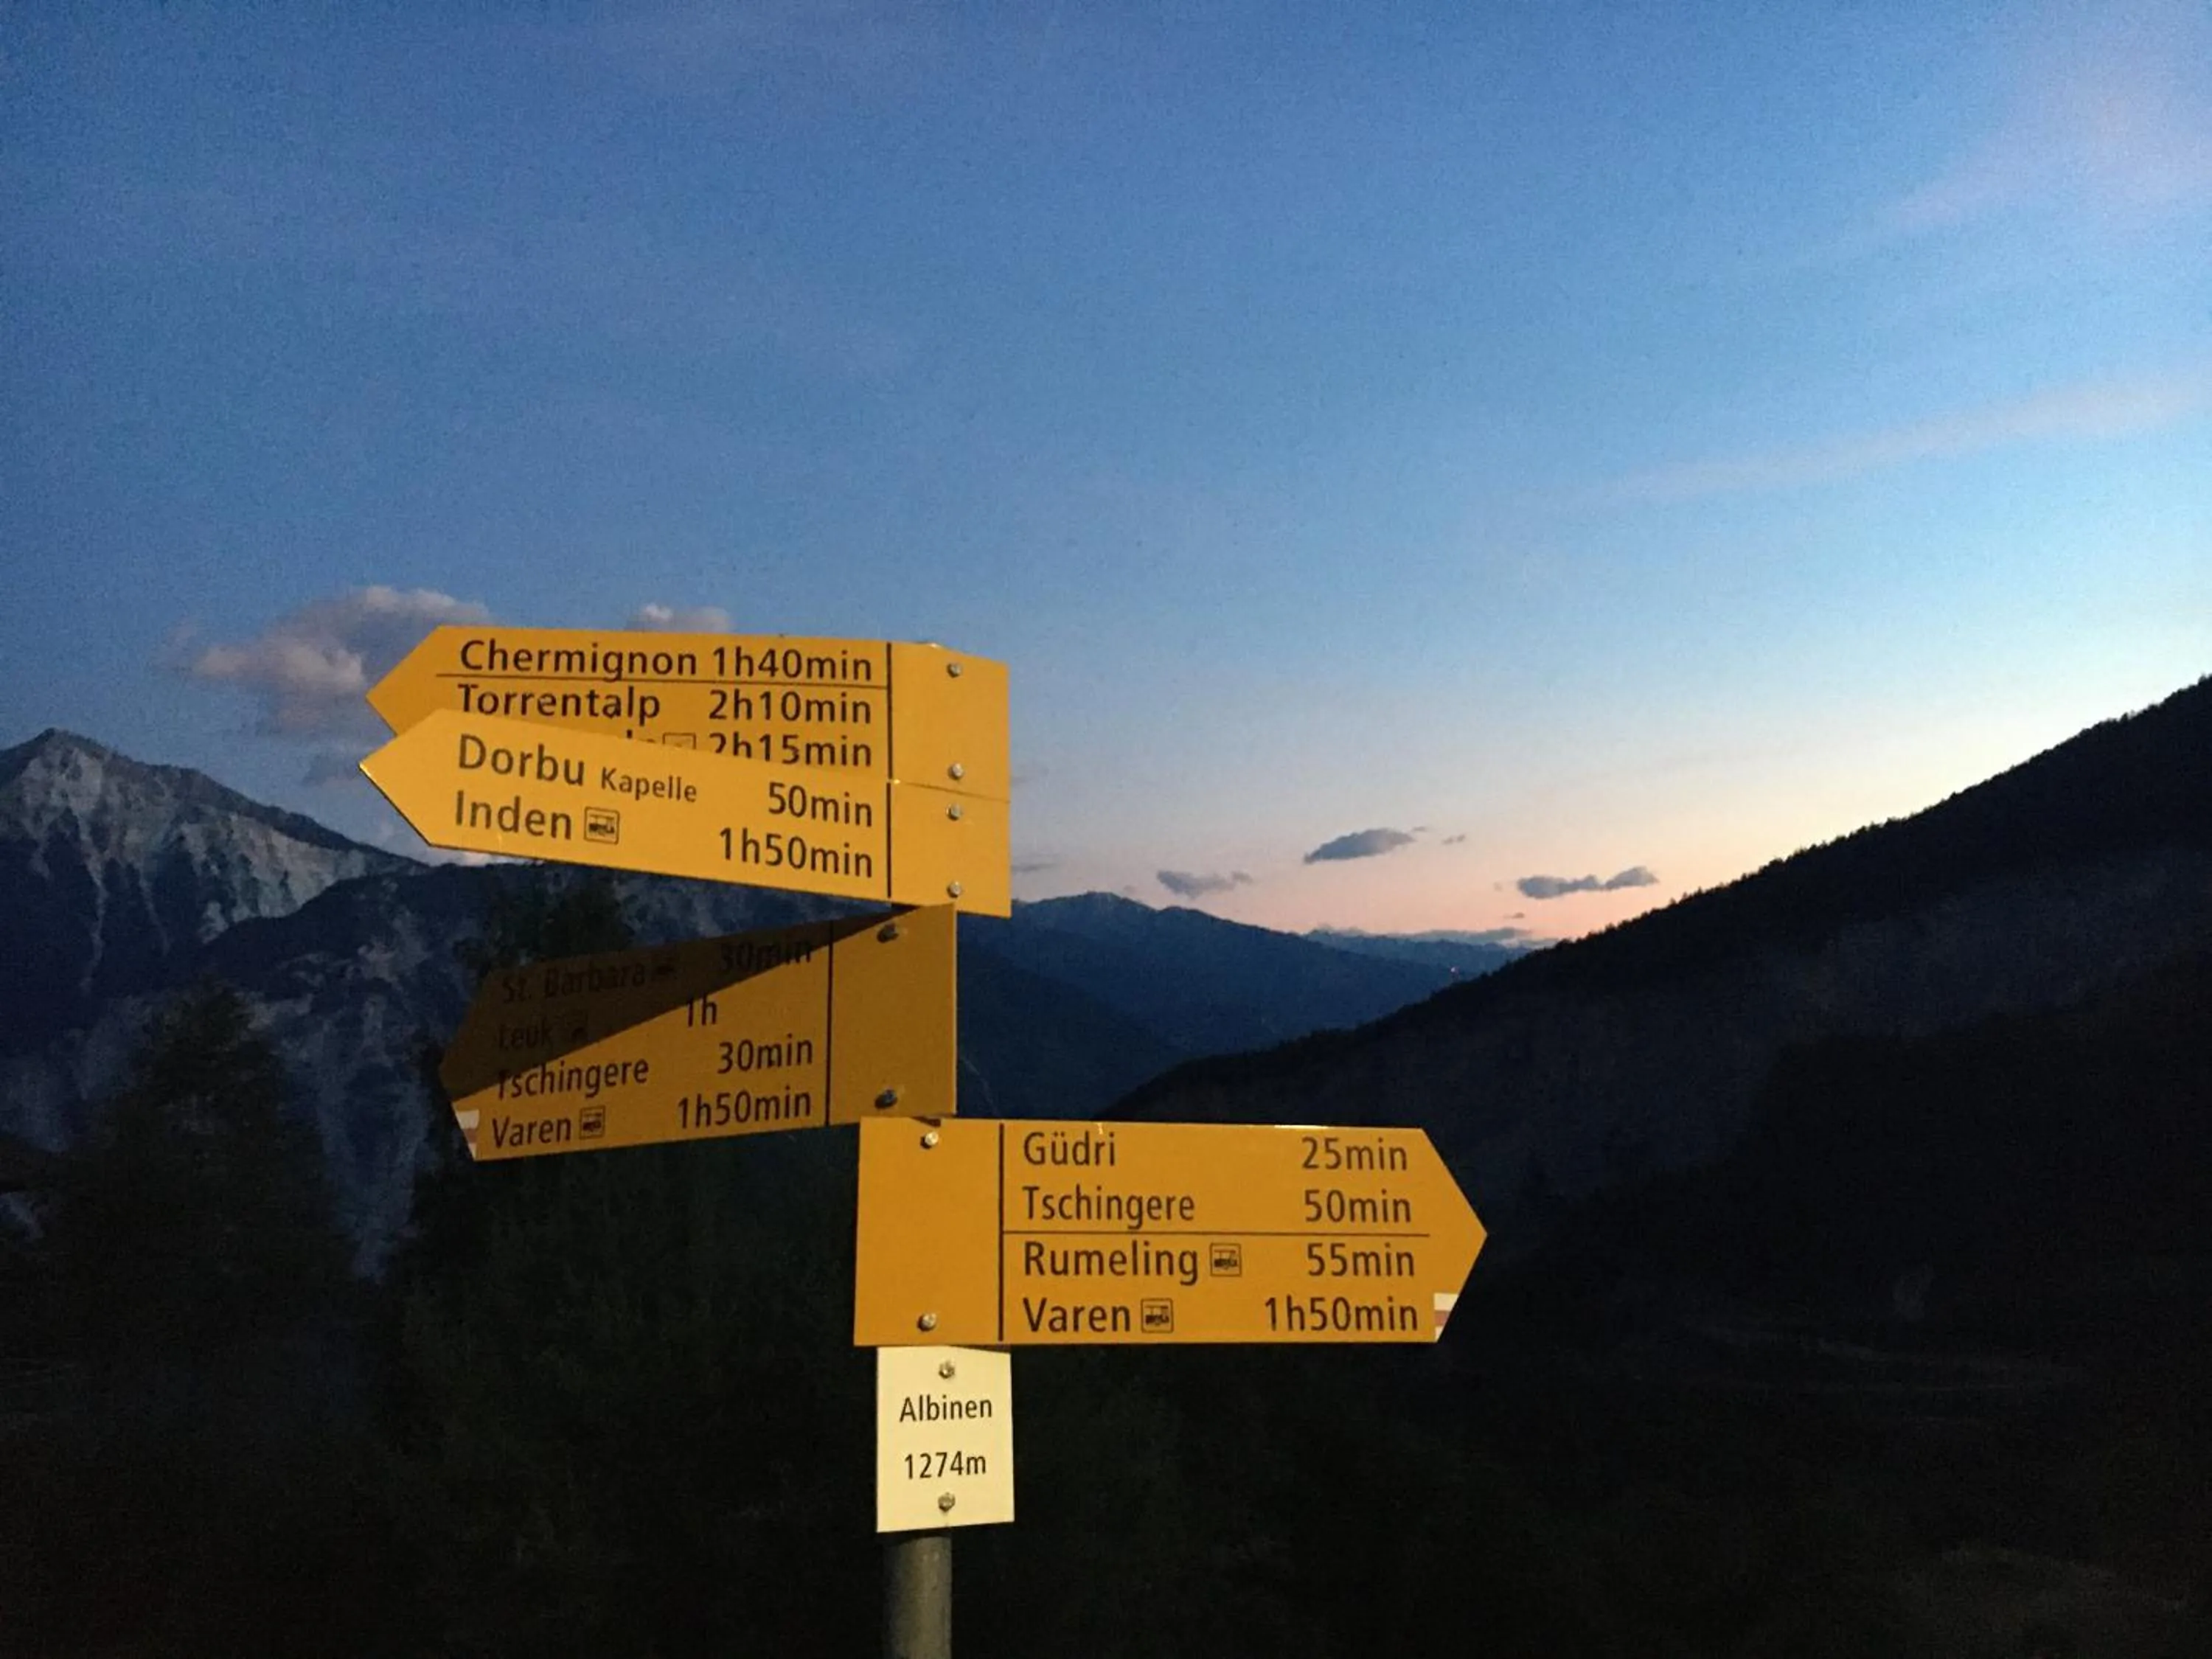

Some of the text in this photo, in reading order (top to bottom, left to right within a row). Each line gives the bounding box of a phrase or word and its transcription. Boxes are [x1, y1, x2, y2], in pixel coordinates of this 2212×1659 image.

[459, 639, 872, 682] Chermignon 1h40min
[457, 683, 872, 725] Torrentalp 2h10min
[710, 731, 872, 768] 2h15min
[459, 734, 872, 828] Dorbu Kapelle 50min
[456, 790, 872, 879] Inden 1h50min
[543, 961, 646, 998] Barbara
[719, 938, 813, 973] 30min
[498, 995, 719, 1051] Leuk 1h
[495, 1032, 813, 1101] Tschingere 30min
[491, 1084, 812, 1150] Varen 1h50min
[1023, 1130, 1408, 1172] Güdri 25min
[1023, 1185, 1411, 1230] Tschingere 50min
[1024, 1239, 1415, 1287] Rumeling 55min
[1022, 1294, 1418, 1333] Varen 1h50min
[899, 1394, 992, 1423] Albinen
[905, 1450, 987, 1480] 1274m
